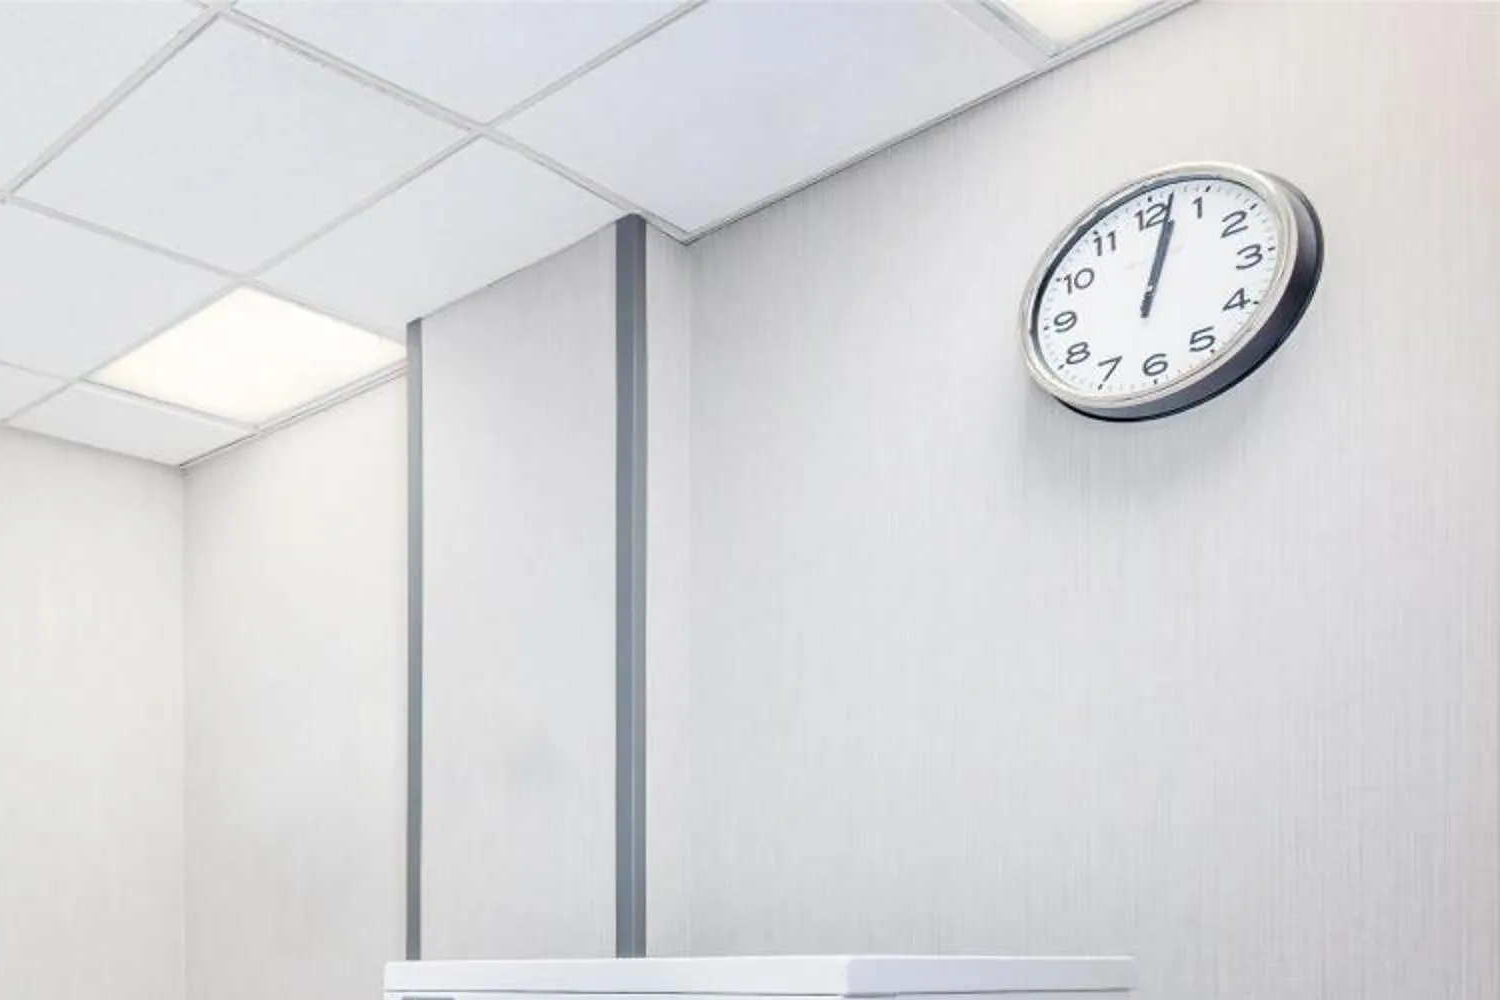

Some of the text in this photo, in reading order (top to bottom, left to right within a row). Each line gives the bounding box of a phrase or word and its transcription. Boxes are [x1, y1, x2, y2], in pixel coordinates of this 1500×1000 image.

[1134, 203, 1168, 231] 12
[1192, 197, 1203, 219] 1
[1220, 210, 1249, 238] 2
[1093, 231, 1118, 256] 11
[1235, 243, 1263, 270] 3
[1063, 267, 1096, 294] 10
[1222, 288, 1250, 311] 4
[1053, 311, 1078, 333] 9
[1189, 326, 1216, 352] 5
[1066, 341, 1090, 365] 8
[1142, 353, 1168, 376] 6
[1098, 355, 1123, 382] 7
